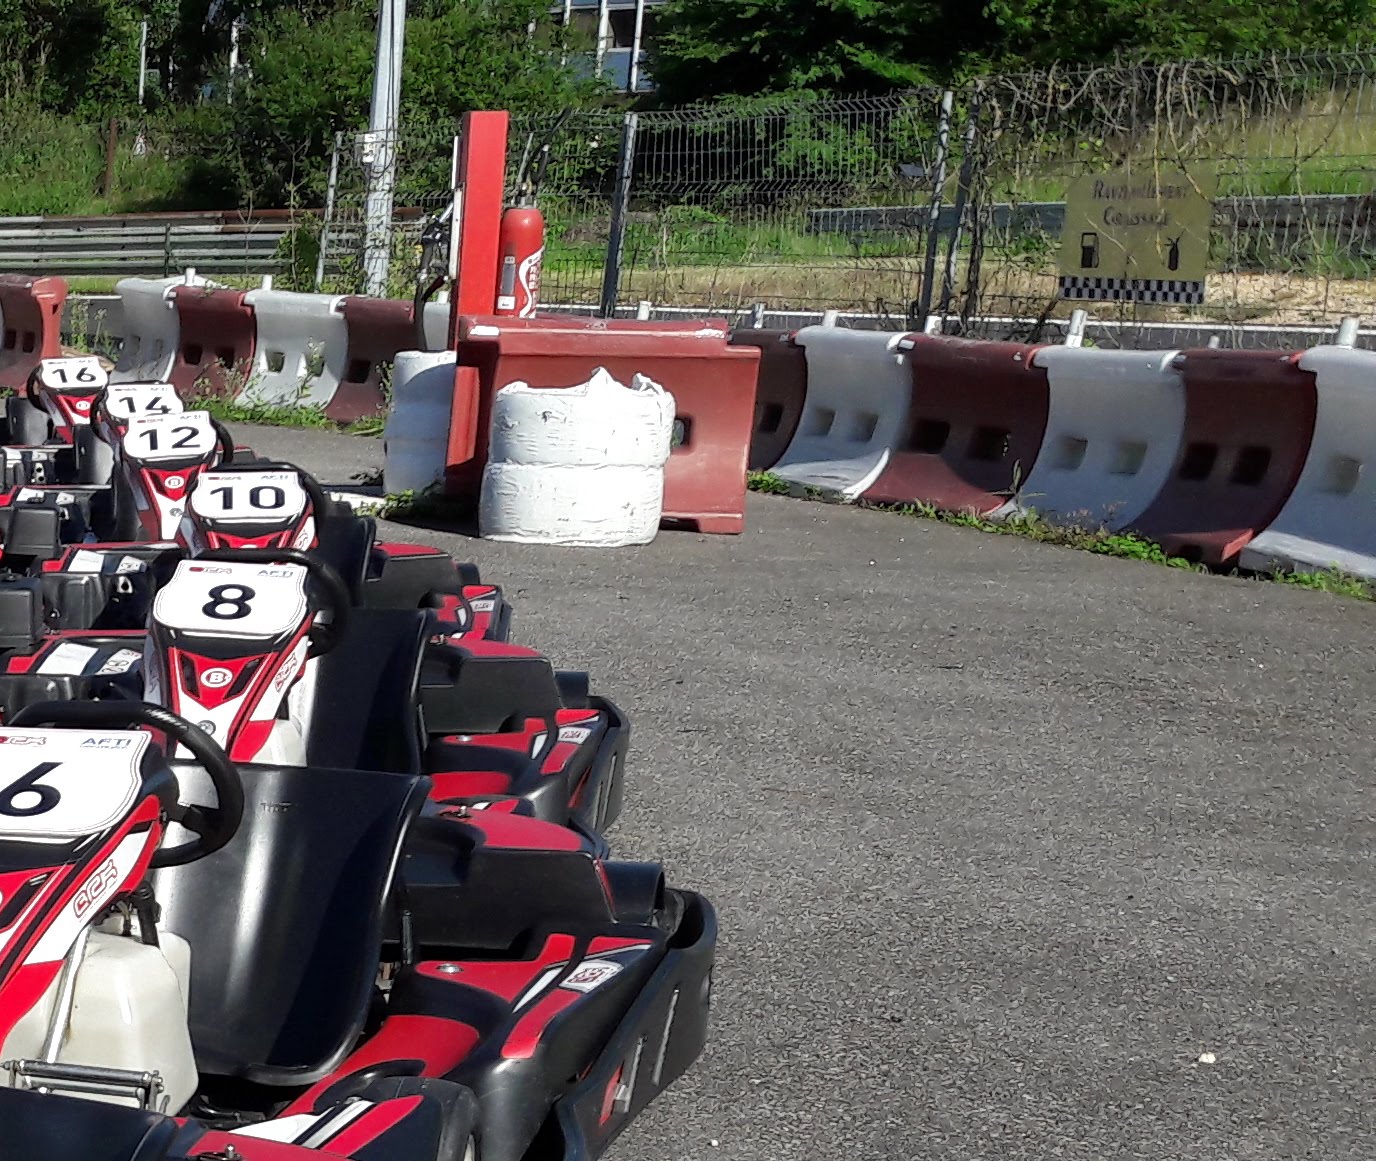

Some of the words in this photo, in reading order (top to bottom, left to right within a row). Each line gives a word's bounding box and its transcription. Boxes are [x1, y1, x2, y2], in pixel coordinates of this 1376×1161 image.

[52, 367, 97, 384] 16
[118, 396, 172, 414] 14
[139, 426, 201, 452] 12
[209, 485, 286, 510] 10
[201, 583, 256, 620] 8
